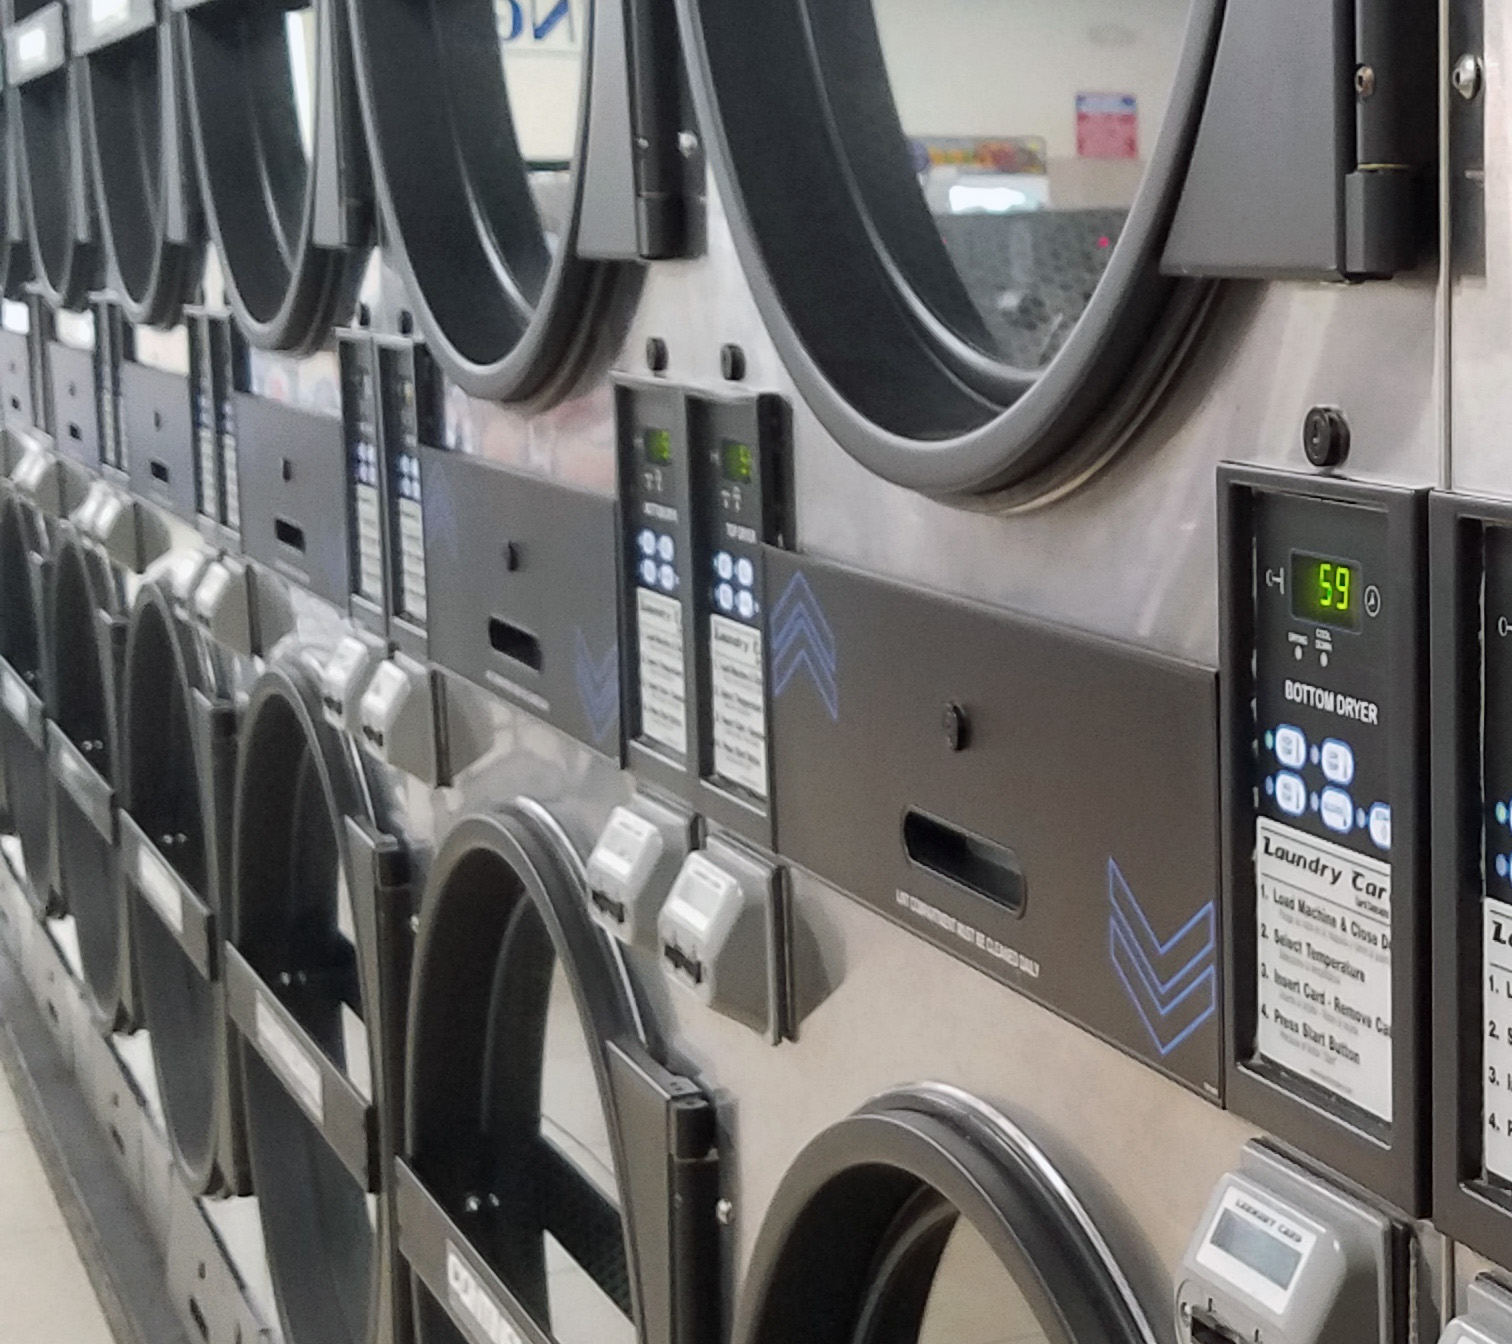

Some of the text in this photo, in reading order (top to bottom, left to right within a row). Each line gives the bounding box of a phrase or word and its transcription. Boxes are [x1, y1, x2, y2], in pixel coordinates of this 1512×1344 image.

[1319, 563, 1350, 611] 59
[1285, 679, 1379, 726] BOTTOM DRYER
[1262, 835, 1388, 900] Laundry Car
[1489, 974, 1499, 994] 1.
[1488, 1020, 1500, 1041] 2.
[1488, 1065, 1500, 1087] 3.
[1488, 1112, 1500, 1131] 4.
